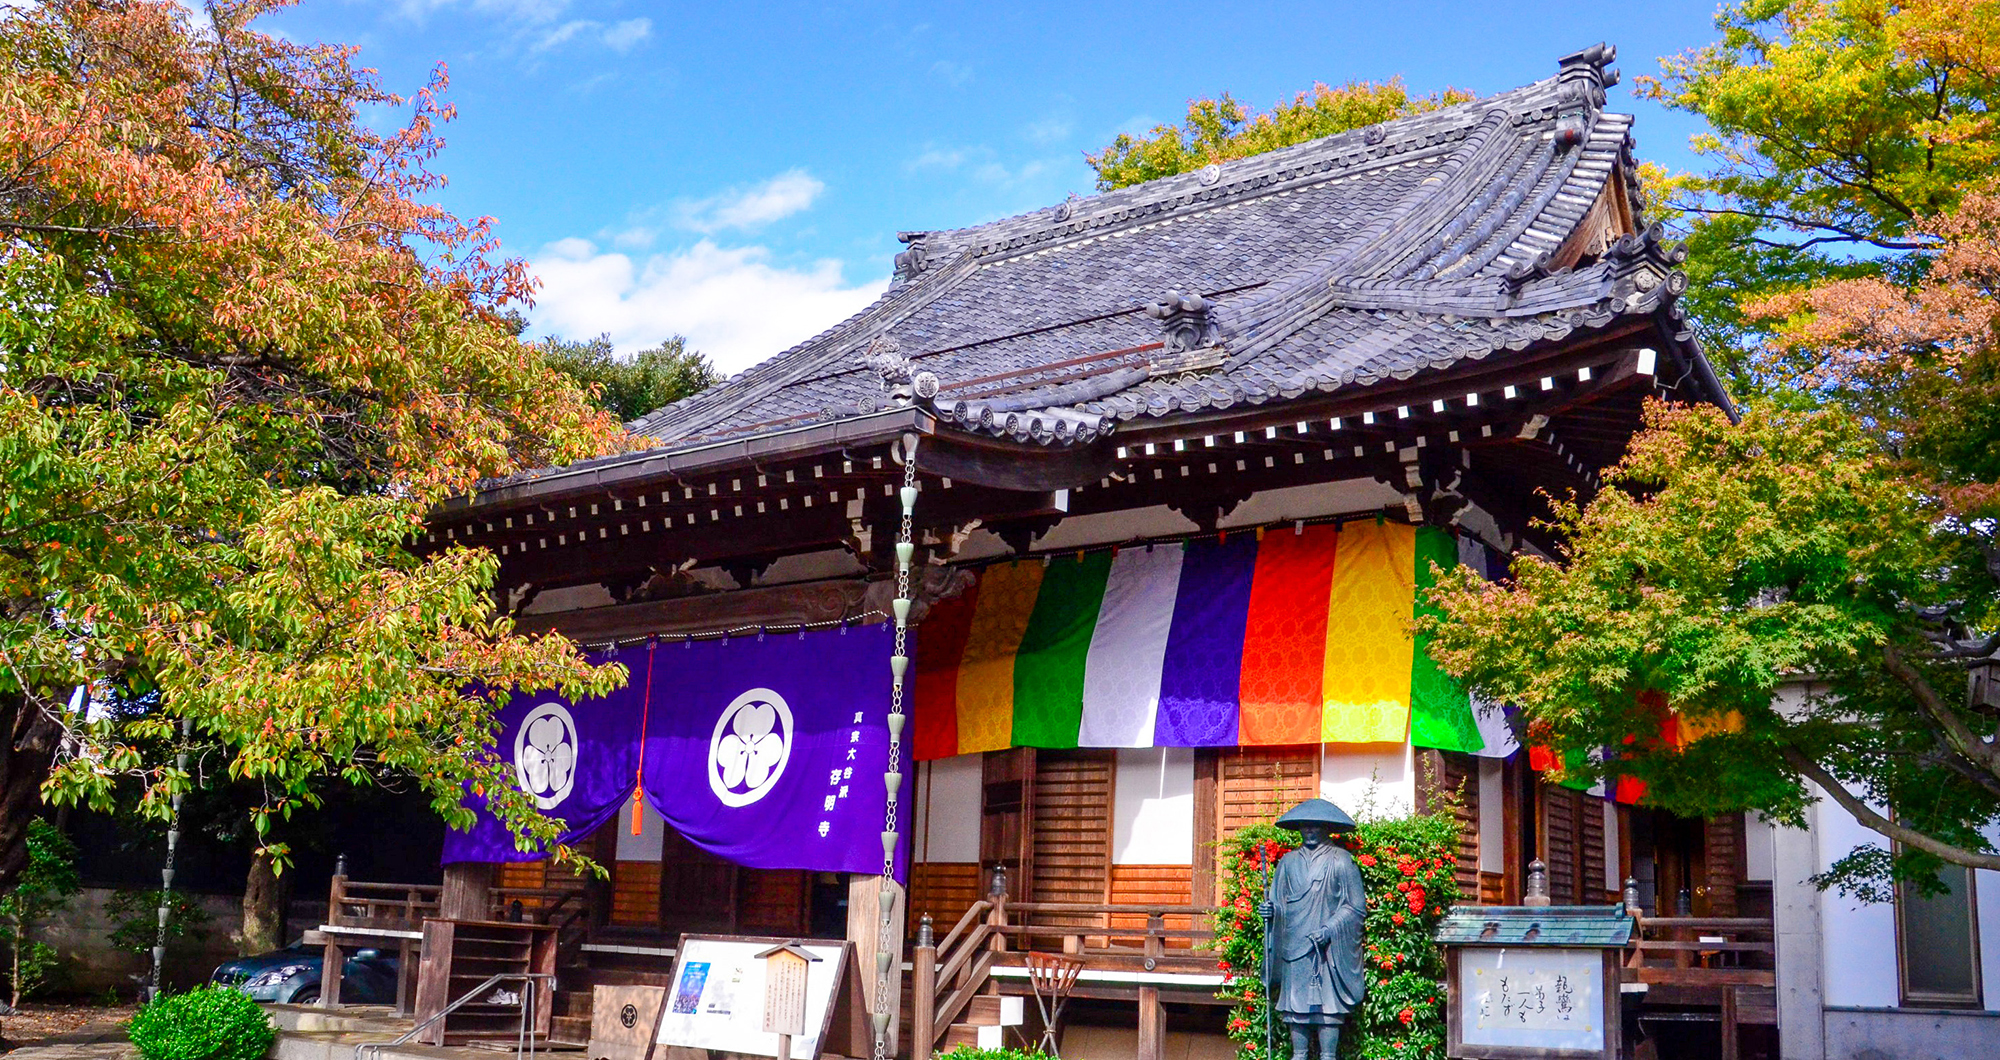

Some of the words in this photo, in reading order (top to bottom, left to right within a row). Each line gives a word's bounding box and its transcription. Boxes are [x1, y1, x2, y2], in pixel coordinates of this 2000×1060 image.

[838, 711, 864, 798] 真宗大谷派
[817, 768, 843, 838] 存明寺
